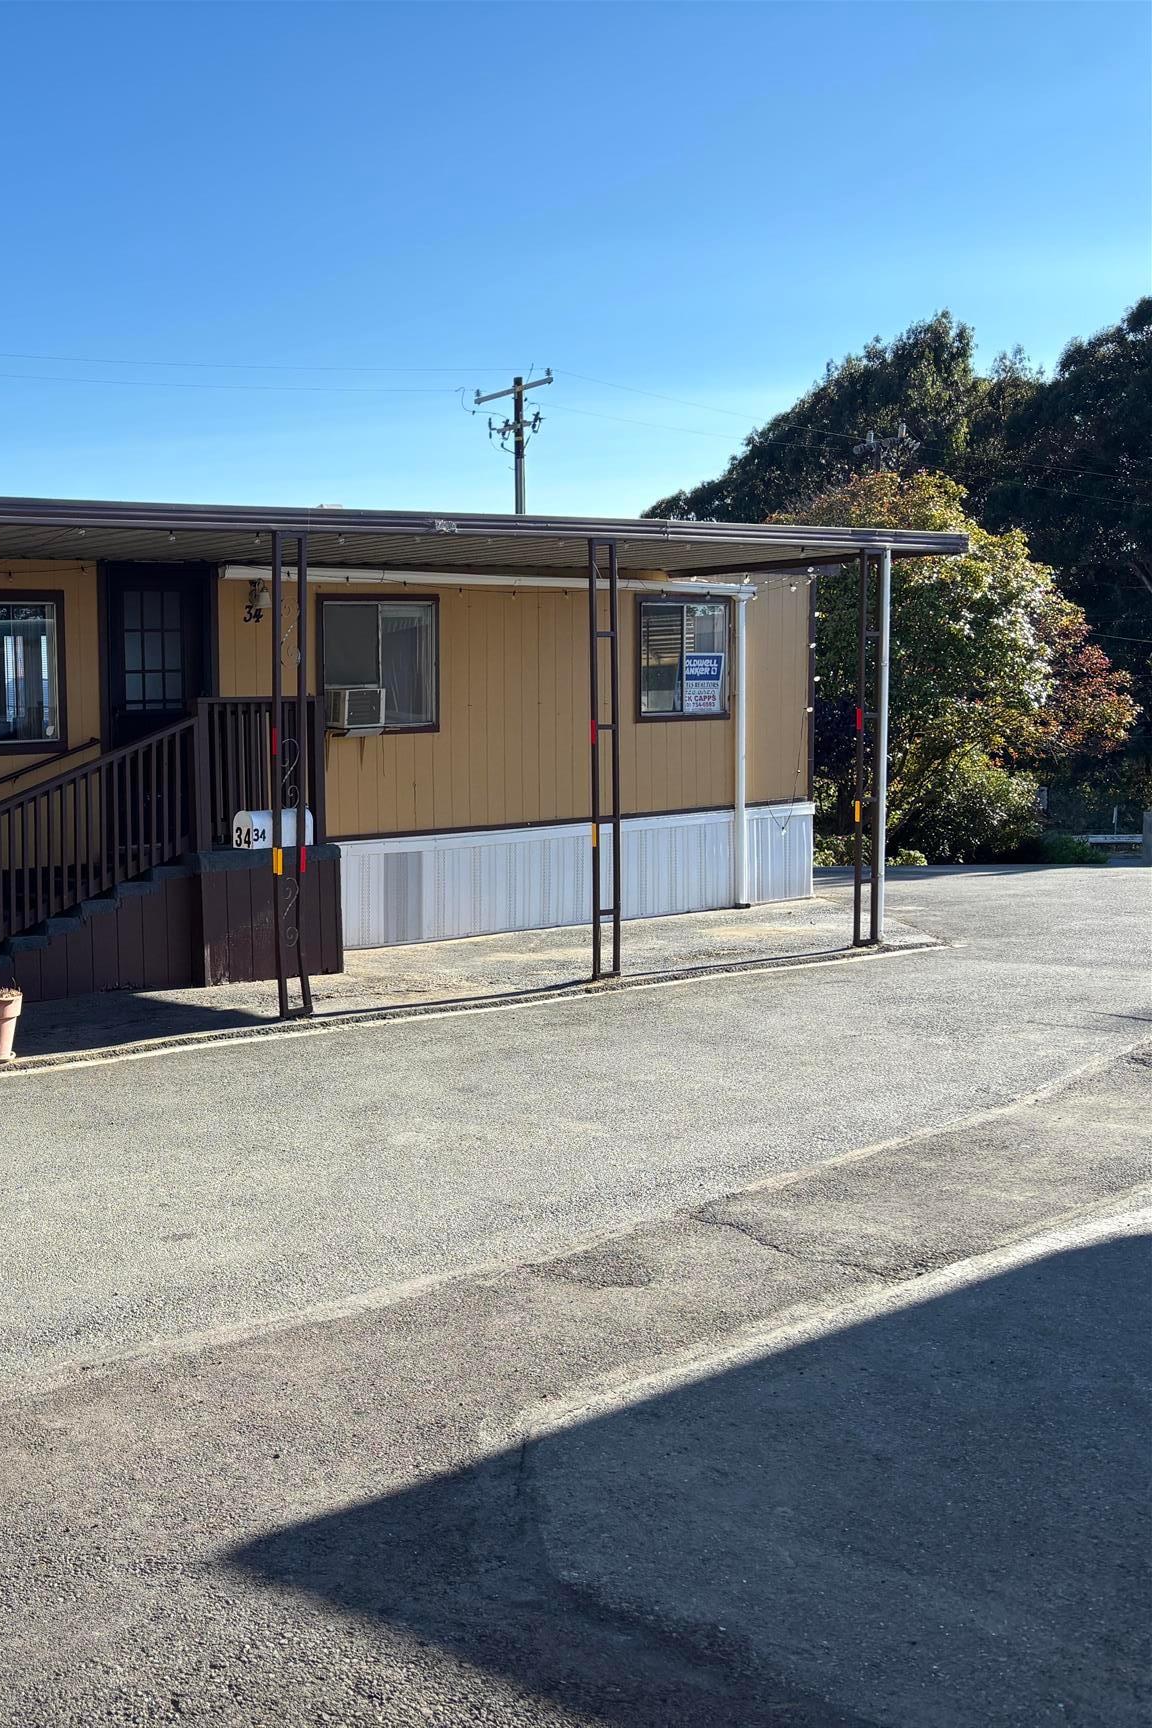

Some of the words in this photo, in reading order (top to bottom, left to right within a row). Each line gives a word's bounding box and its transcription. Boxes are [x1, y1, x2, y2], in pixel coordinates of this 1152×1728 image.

[243, 604, 264, 623] 34
[685, 659, 718, 667] OLDWeLL
[685, 667, 710, 676] ANKeR
[235, 827, 251, 848] 34
[253, 828, 266, 842] 34
